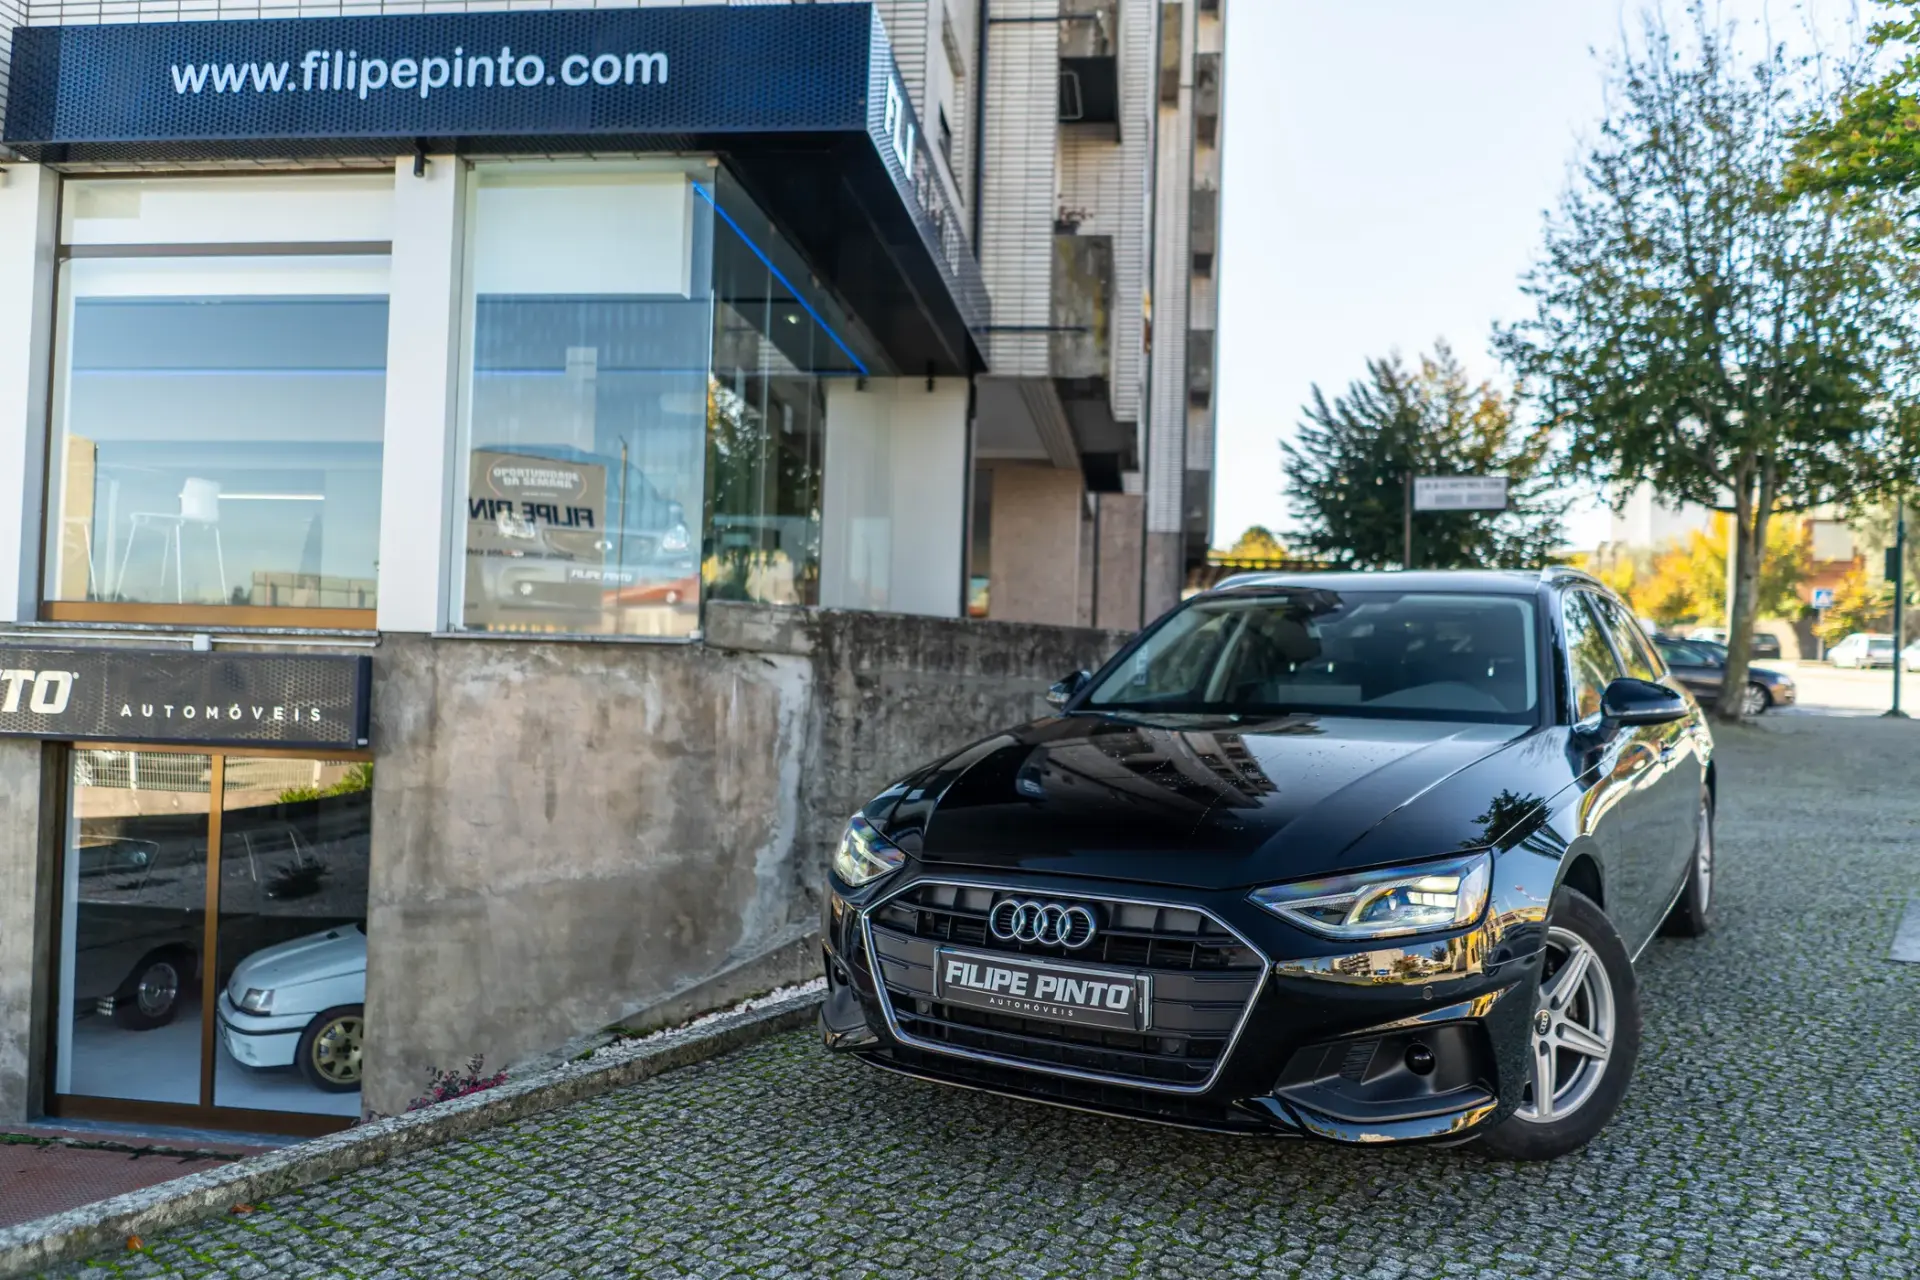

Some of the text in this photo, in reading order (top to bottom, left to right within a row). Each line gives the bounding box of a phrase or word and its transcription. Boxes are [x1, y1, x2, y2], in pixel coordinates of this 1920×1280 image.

[171, 46, 669, 99] www.filipepinto.com
[493, 467, 579, 482] OPORTUNIDADE
[0, 669, 321, 721] TO AUTOMÓVEIS
[945, 959, 1029, 996] FILIPE
[1034, 974, 1131, 1010] PINTO
[989, 997, 1074, 1017] AUTOMÓVEIS
